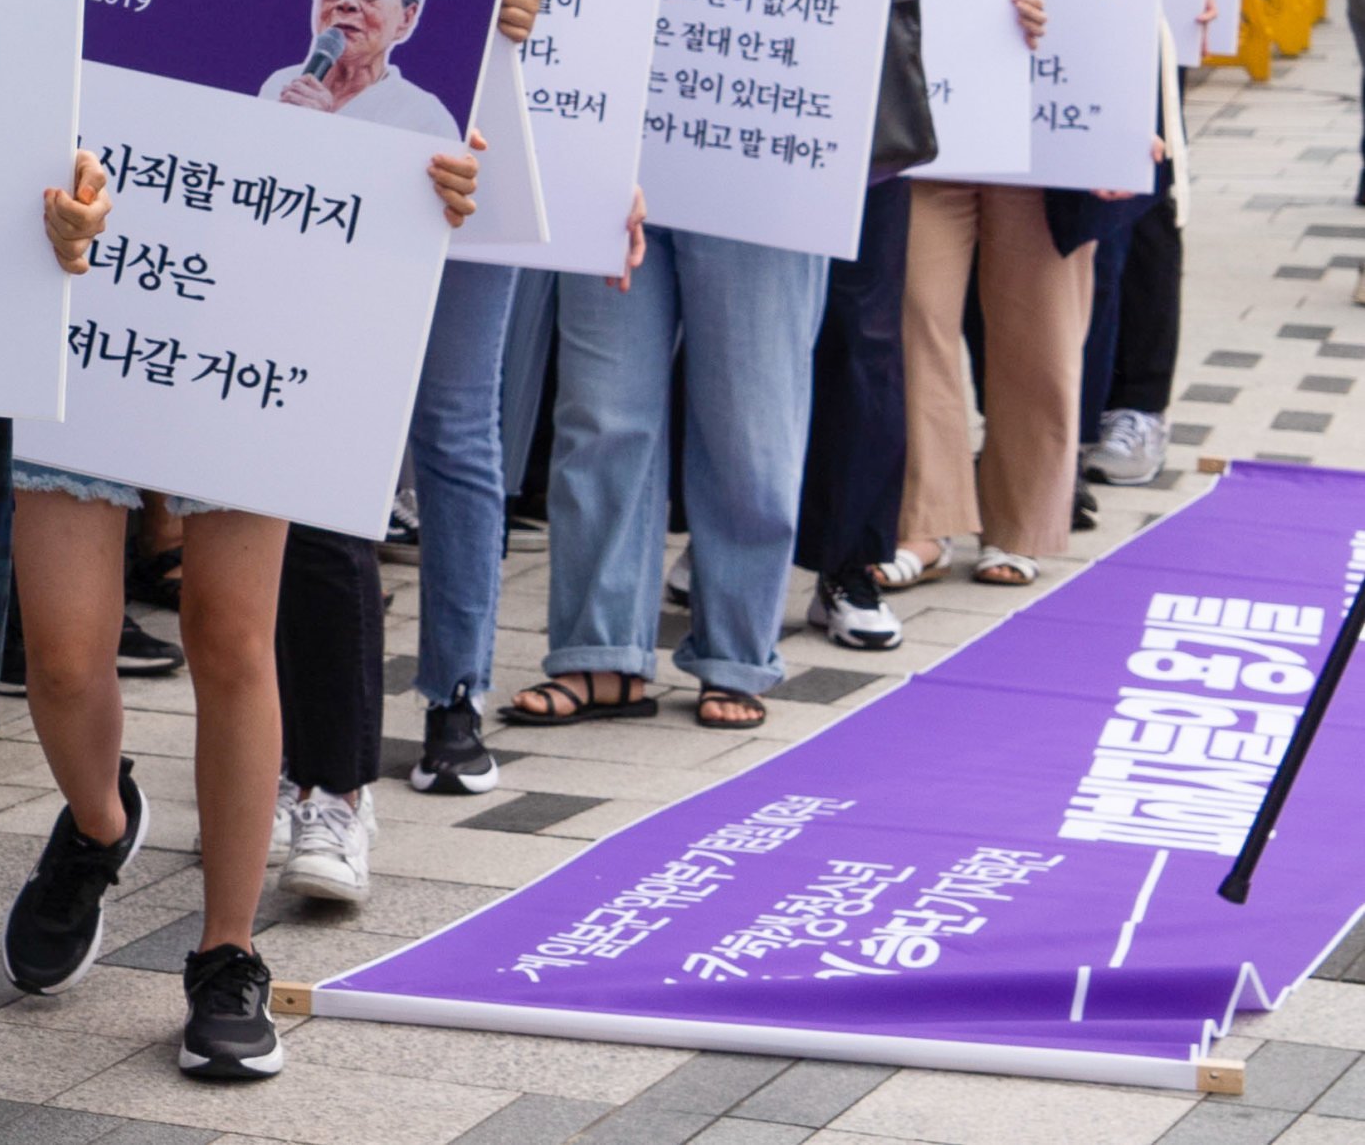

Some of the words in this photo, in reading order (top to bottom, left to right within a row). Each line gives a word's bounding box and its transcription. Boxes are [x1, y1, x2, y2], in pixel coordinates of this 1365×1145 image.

[682, 21, 731, 58] 절대
[737, 31, 764, 62] 안
[526, 89, 606, 123] 으면서
[675, 67, 724, 104] 일이
[731, 78, 832, 119] 있더라도
[683, 118, 732, 151] 내고
[740, 127, 766, 159] 말
[99, 143, 225, 212] 사죄할
[232, 175, 362, 245] 때까지
[1126, 593, 1325, 695] 용기를
